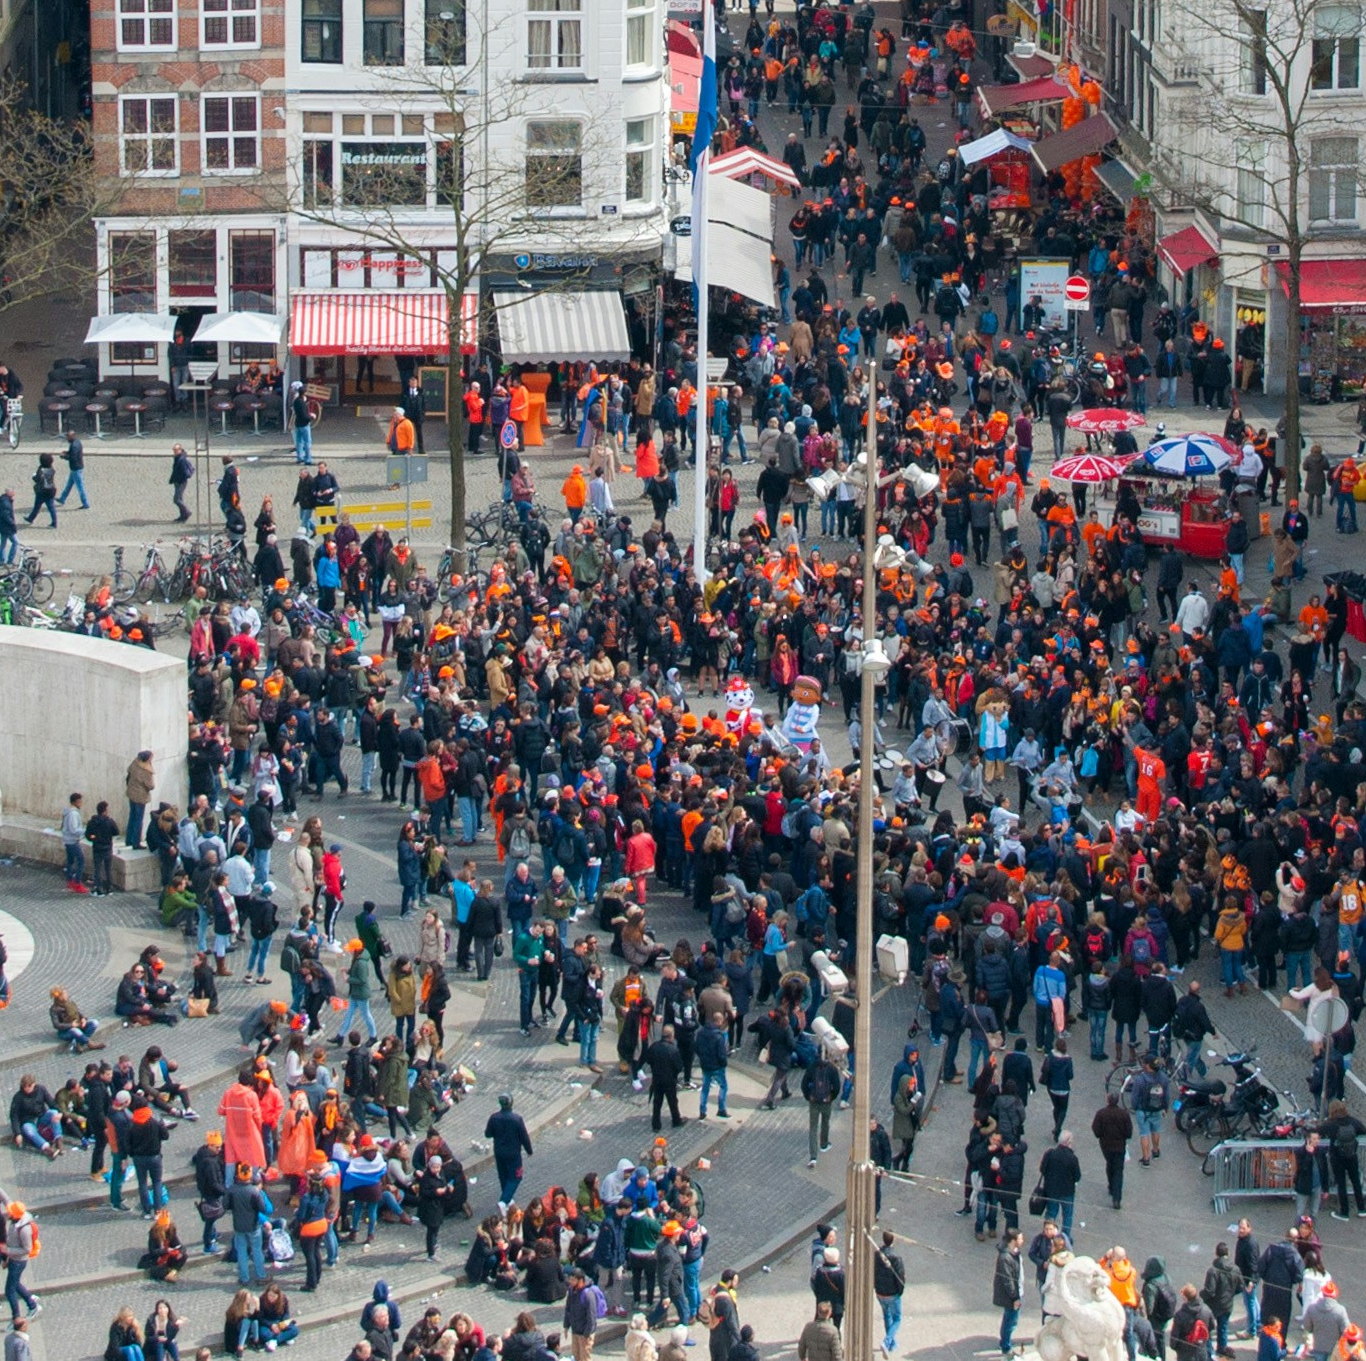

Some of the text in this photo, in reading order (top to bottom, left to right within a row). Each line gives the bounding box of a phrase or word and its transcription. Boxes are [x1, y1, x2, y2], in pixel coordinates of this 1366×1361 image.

[341, 152, 427, 164] Restaurant
[360, 256, 423, 272] Happiness
[1142, 762, 1153, 777] 16
[1200, 757, 1210, 771] 7
